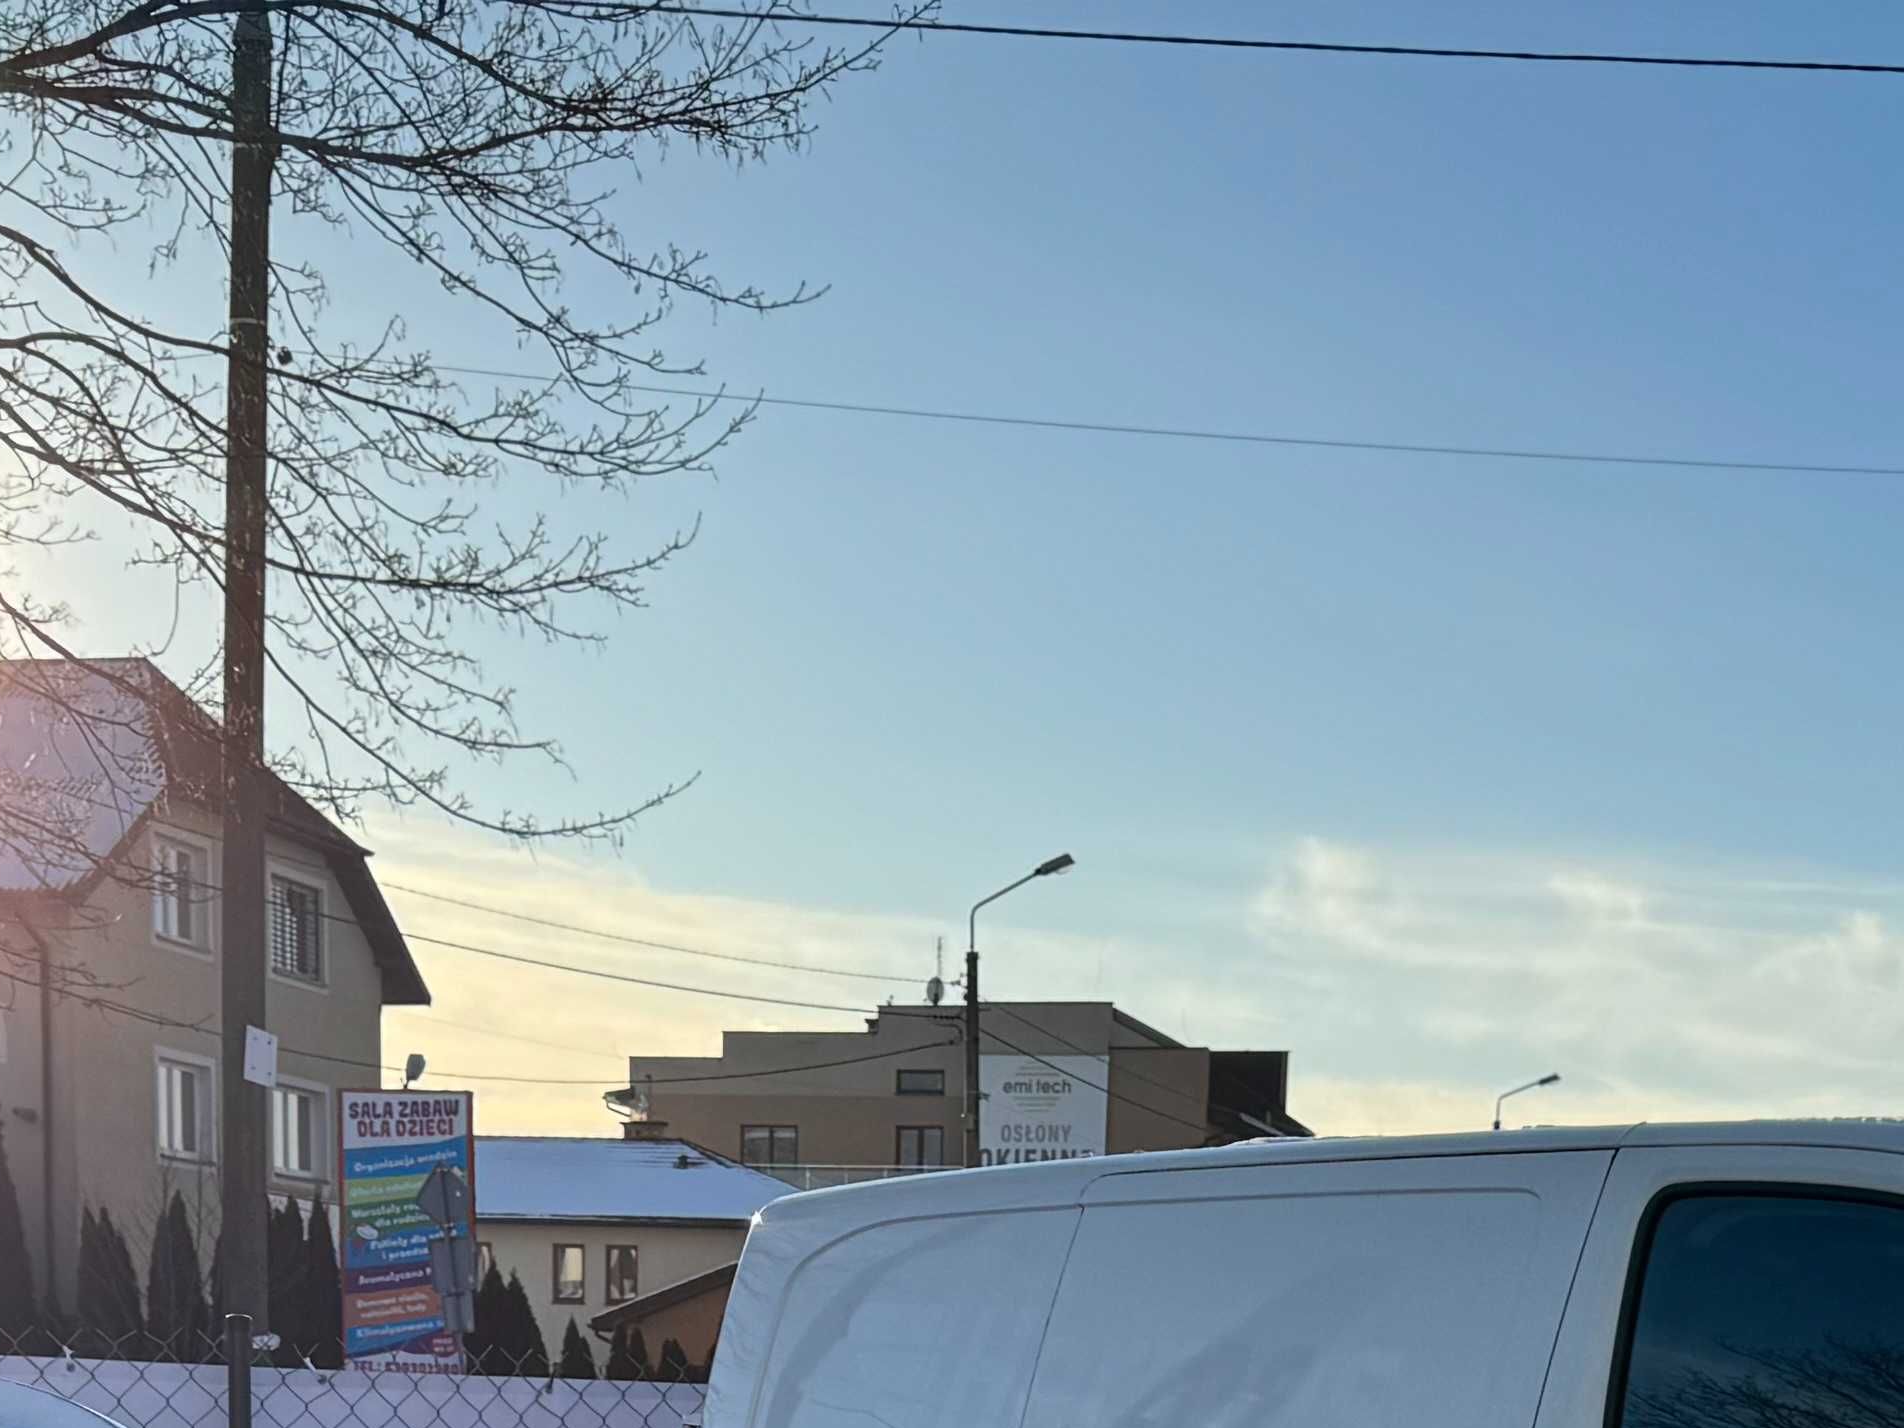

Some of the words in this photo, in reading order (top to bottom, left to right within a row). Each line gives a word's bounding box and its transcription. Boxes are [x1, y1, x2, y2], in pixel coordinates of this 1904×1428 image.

[348, 1101, 393, 1120] SALA
[399, 1099, 459, 1118] ZABAW
[357, 1120, 391, 1138] DLA
[396, 1118, 454, 1137] DZIECI
[1000, 1123, 1072, 1143] OSŁONY
